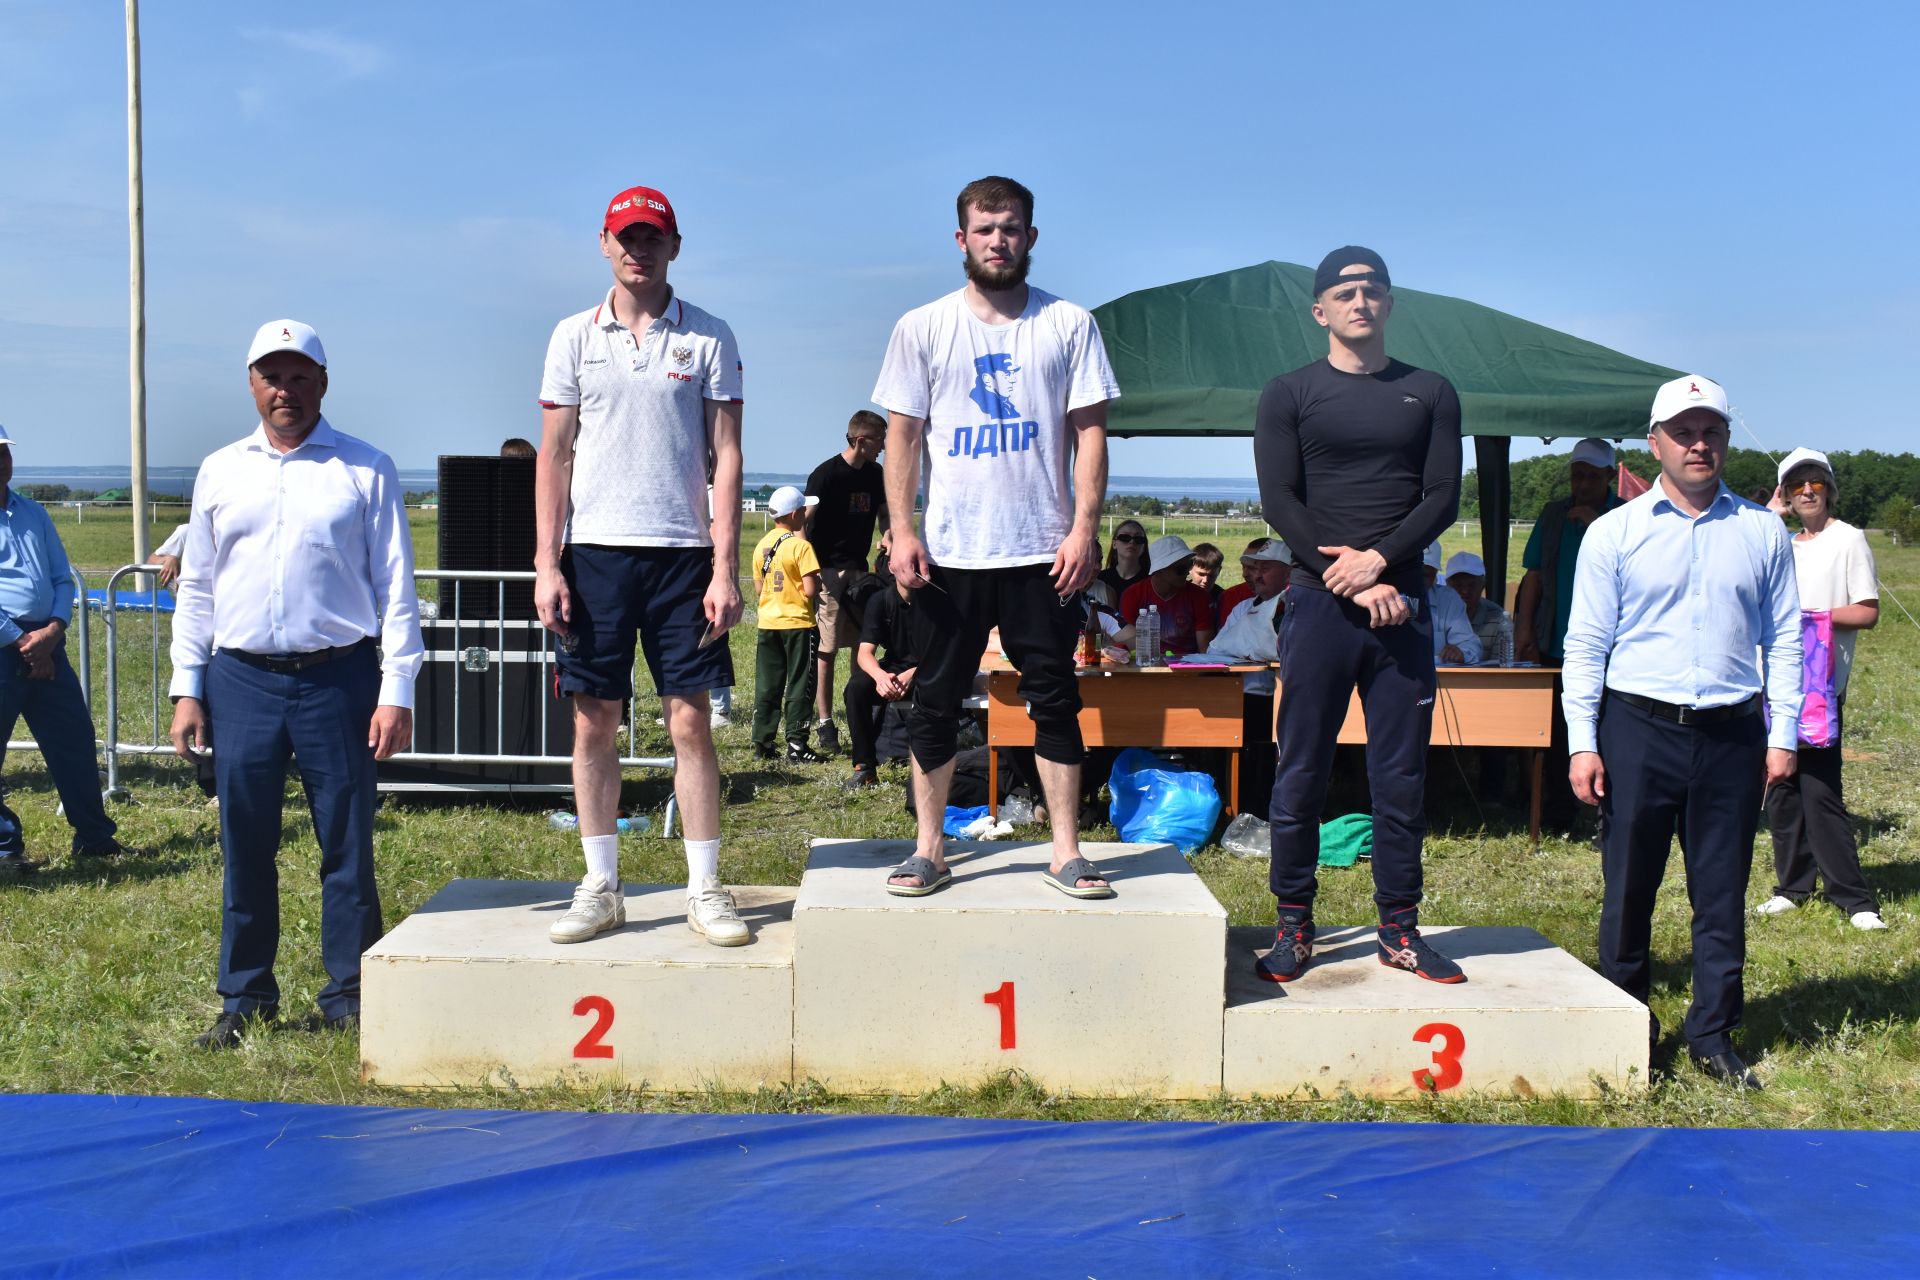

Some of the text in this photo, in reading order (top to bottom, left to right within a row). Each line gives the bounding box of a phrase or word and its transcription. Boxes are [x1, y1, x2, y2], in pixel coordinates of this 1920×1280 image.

[611, 199, 666, 213] RUS SIA
[667, 371, 692, 382] RUS
[947, 420, 1039, 460] ЛДПР
[572, 995, 615, 1060] 2
[983, 981, 1017, 1051] 1
[1412, 1022, 1467, 1092] 3
